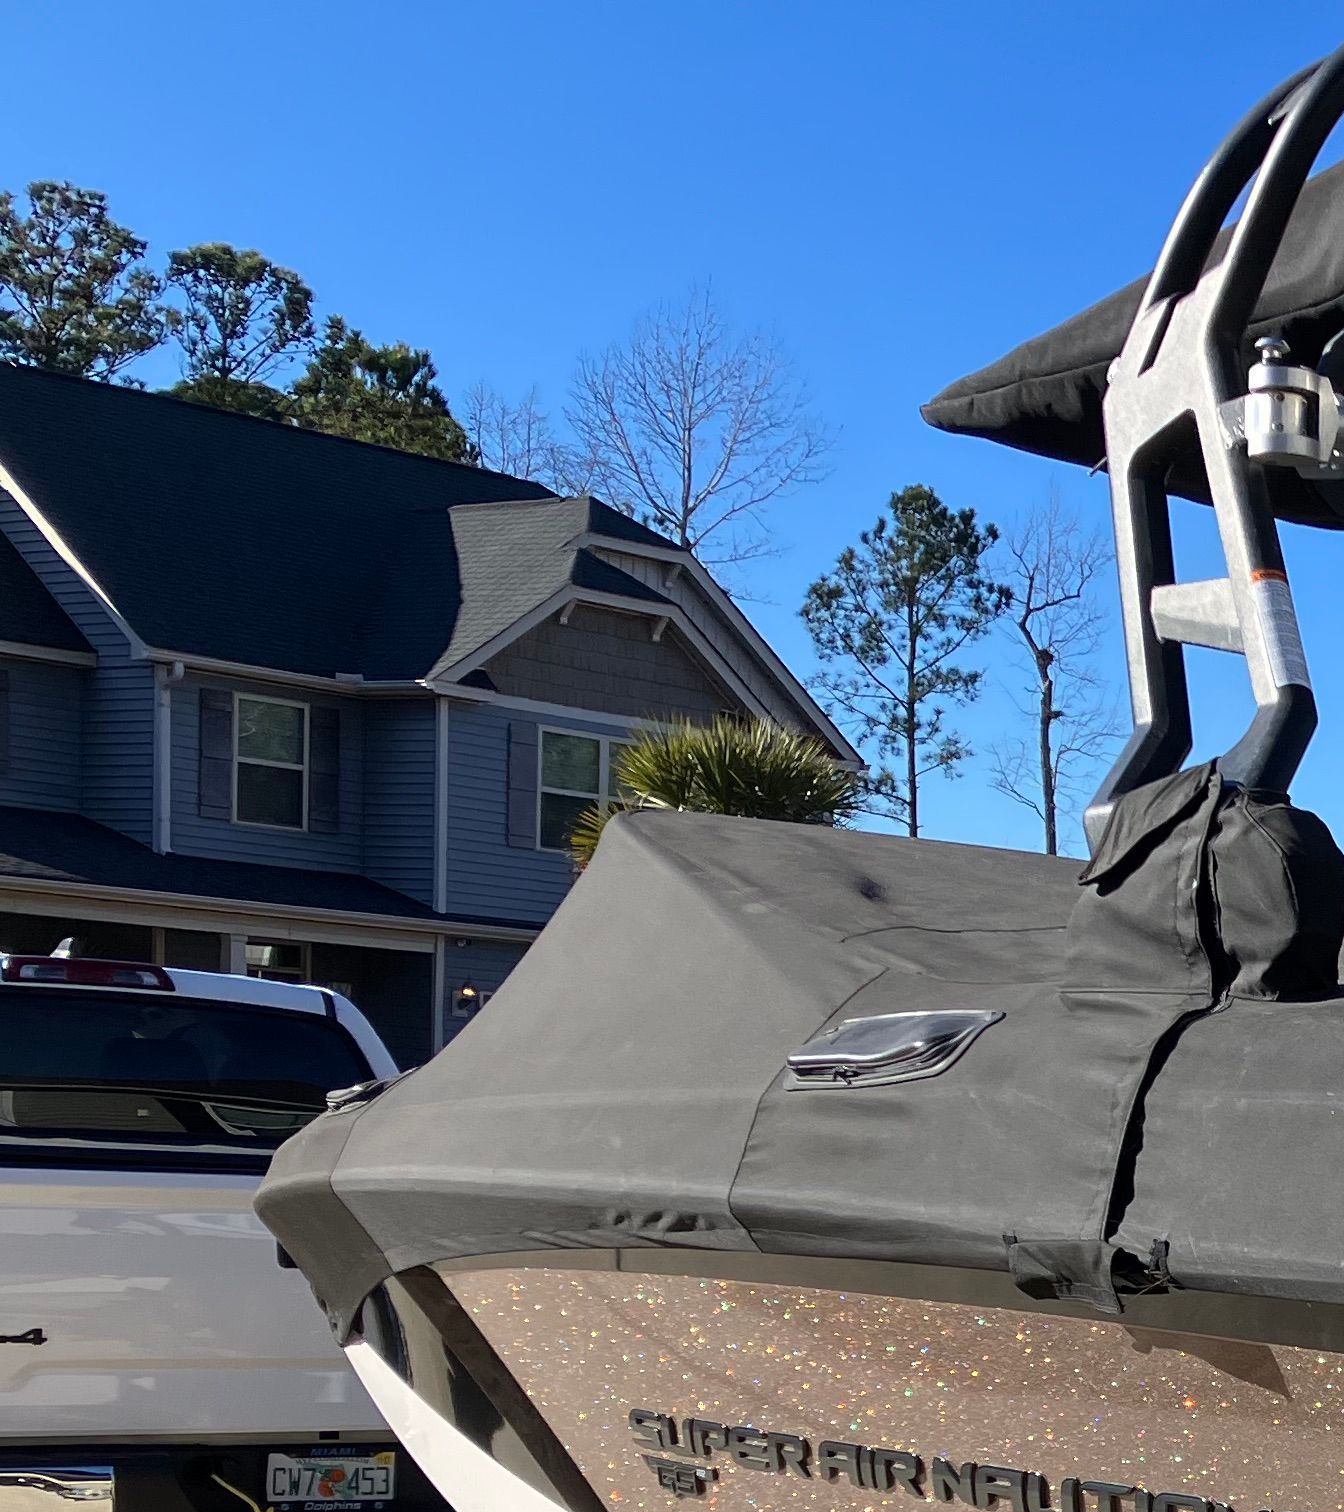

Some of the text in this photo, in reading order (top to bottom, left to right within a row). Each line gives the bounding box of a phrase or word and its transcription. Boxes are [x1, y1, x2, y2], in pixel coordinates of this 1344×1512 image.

[629, 1408, 813, 1480] SUPER
[818, 1440, 926, 1500] AIR
[347, 1466, 389, 1496] 453
[304, 1501, 362, 1512] Dolphins
